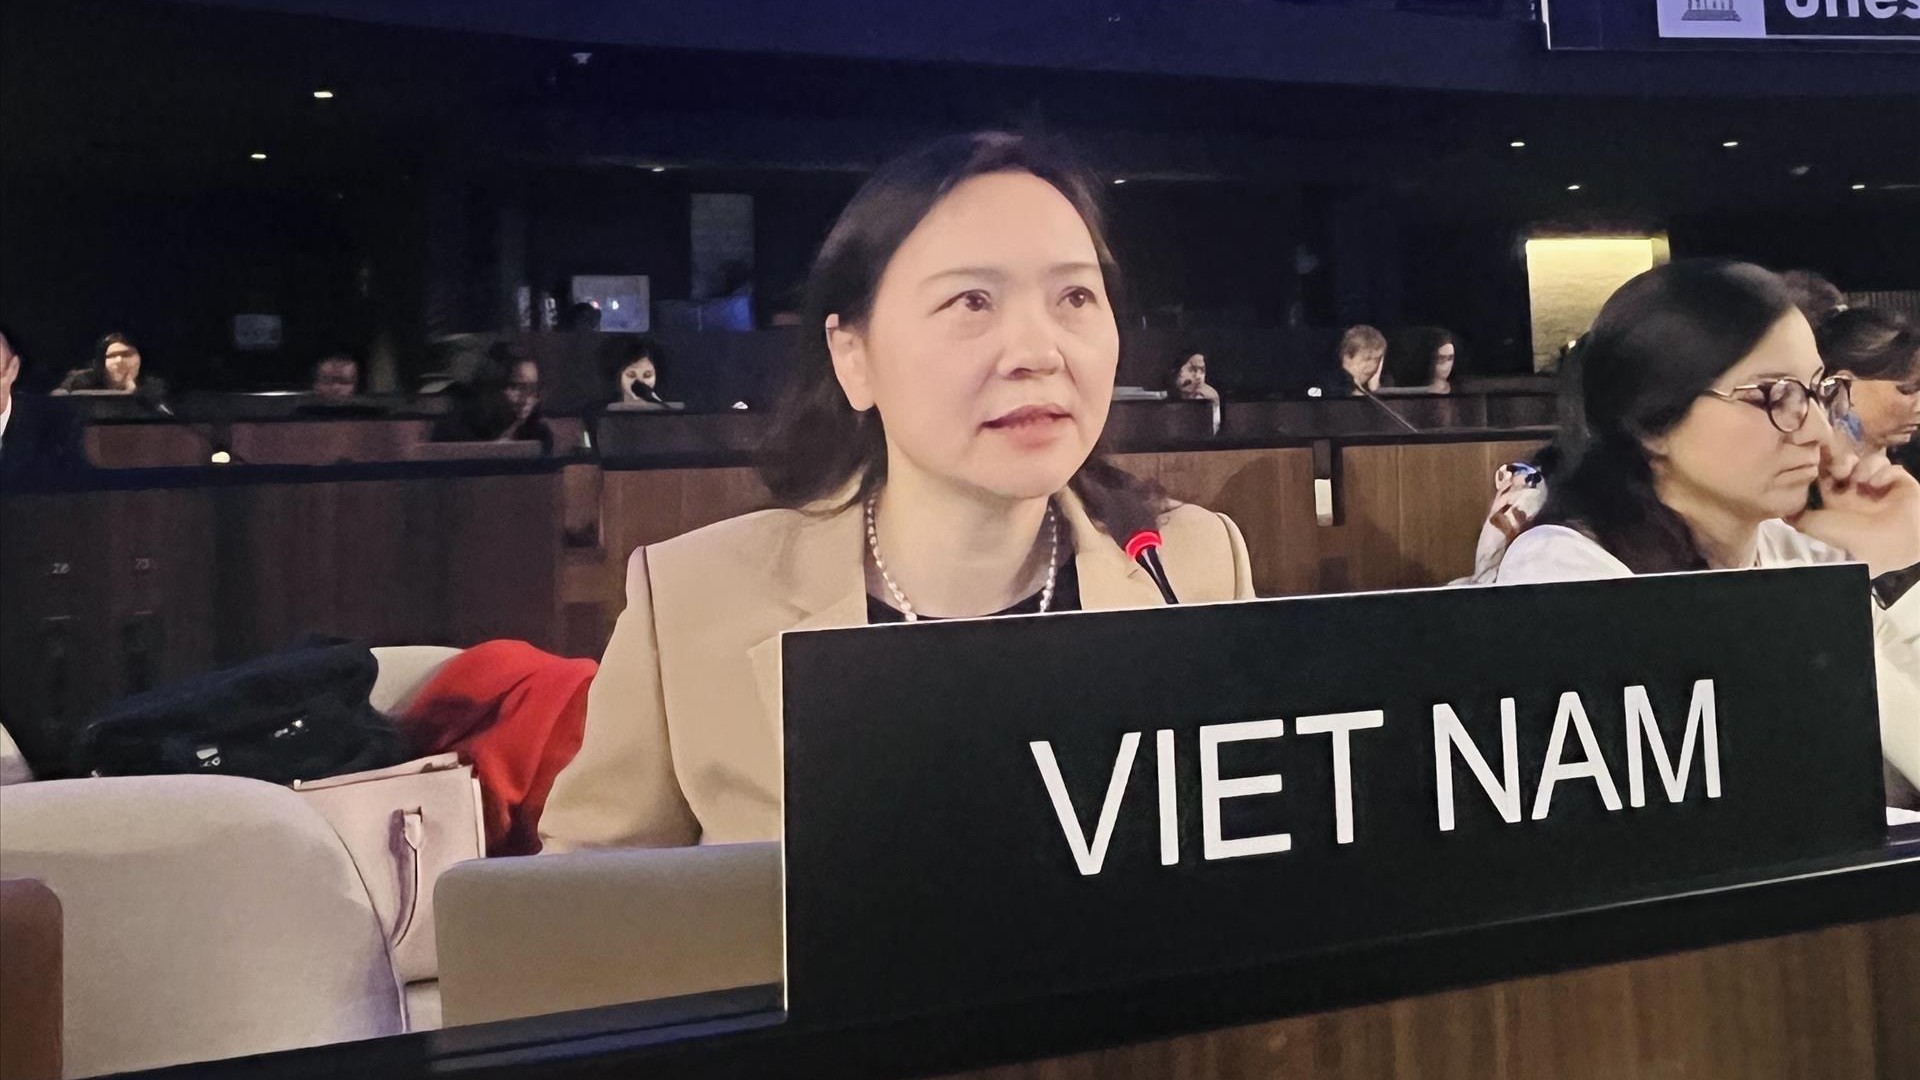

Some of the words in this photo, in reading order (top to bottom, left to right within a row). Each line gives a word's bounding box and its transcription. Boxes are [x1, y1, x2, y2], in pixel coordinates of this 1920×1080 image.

[1785, 0, 1920, 19] une
[1029, 709, 1384, 876] VIET
[1432, 678, 1722, 832] NAM
